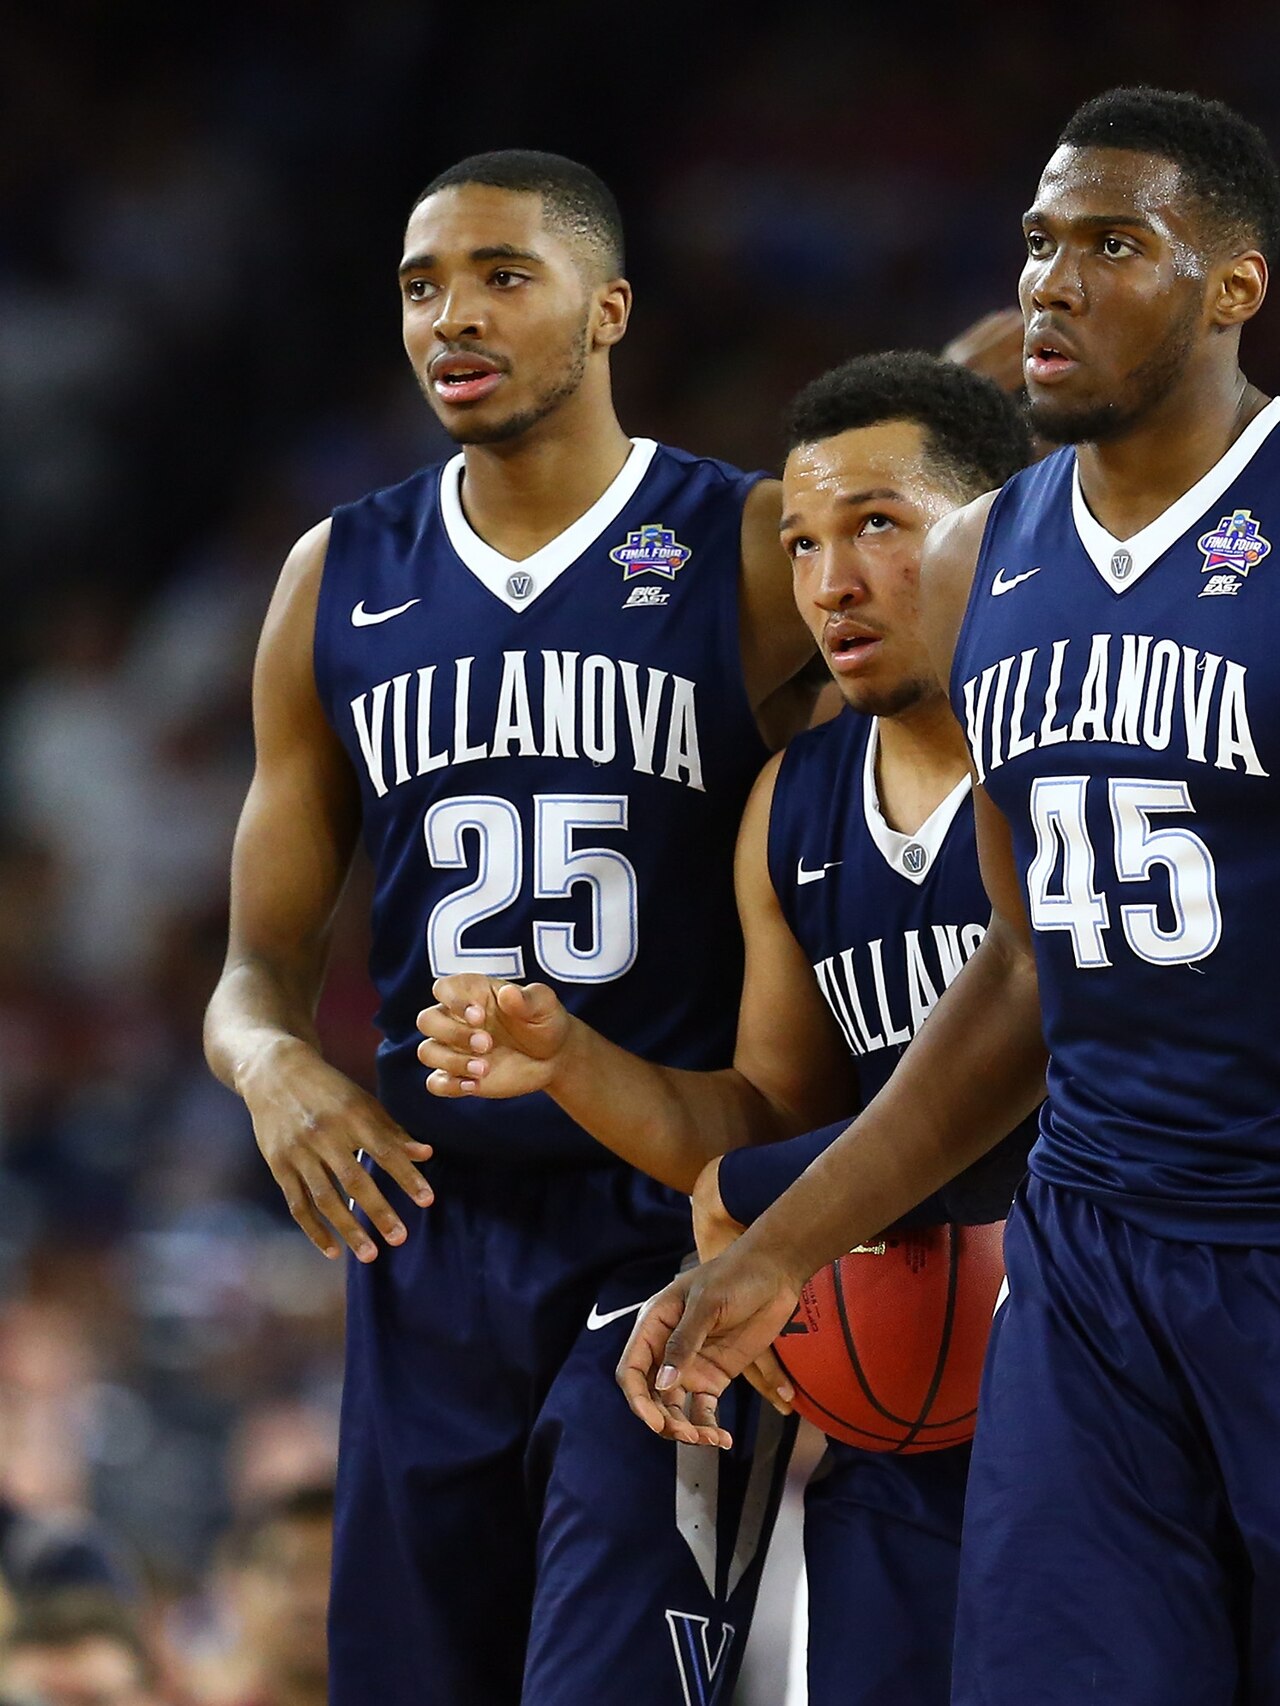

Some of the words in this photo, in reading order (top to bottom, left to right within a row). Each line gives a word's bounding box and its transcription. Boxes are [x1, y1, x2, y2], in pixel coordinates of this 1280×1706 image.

[620, 548, 650, 560] FINAL
[1205, 536, 1233, 548] FINAL
[1233, 538, 1262, 551] FOUR
[1113, 556, 1128, 577] V
[510, 576, 530, 597] V
[1203, 583, 1243, 592] EAST
[1208, 575, 1237, 584] BIG
[626, 594, 670, 603] EAST
[631, 586, 662, 595] BIG
[962, 633, 1270, 785] VILLANOVA
[351, 650, 706, 798] VILLANOVA
[904, 848, 922, 871] V
[1027, 775, 1223, 968] 45
[424, 794, 638, 983] 25
